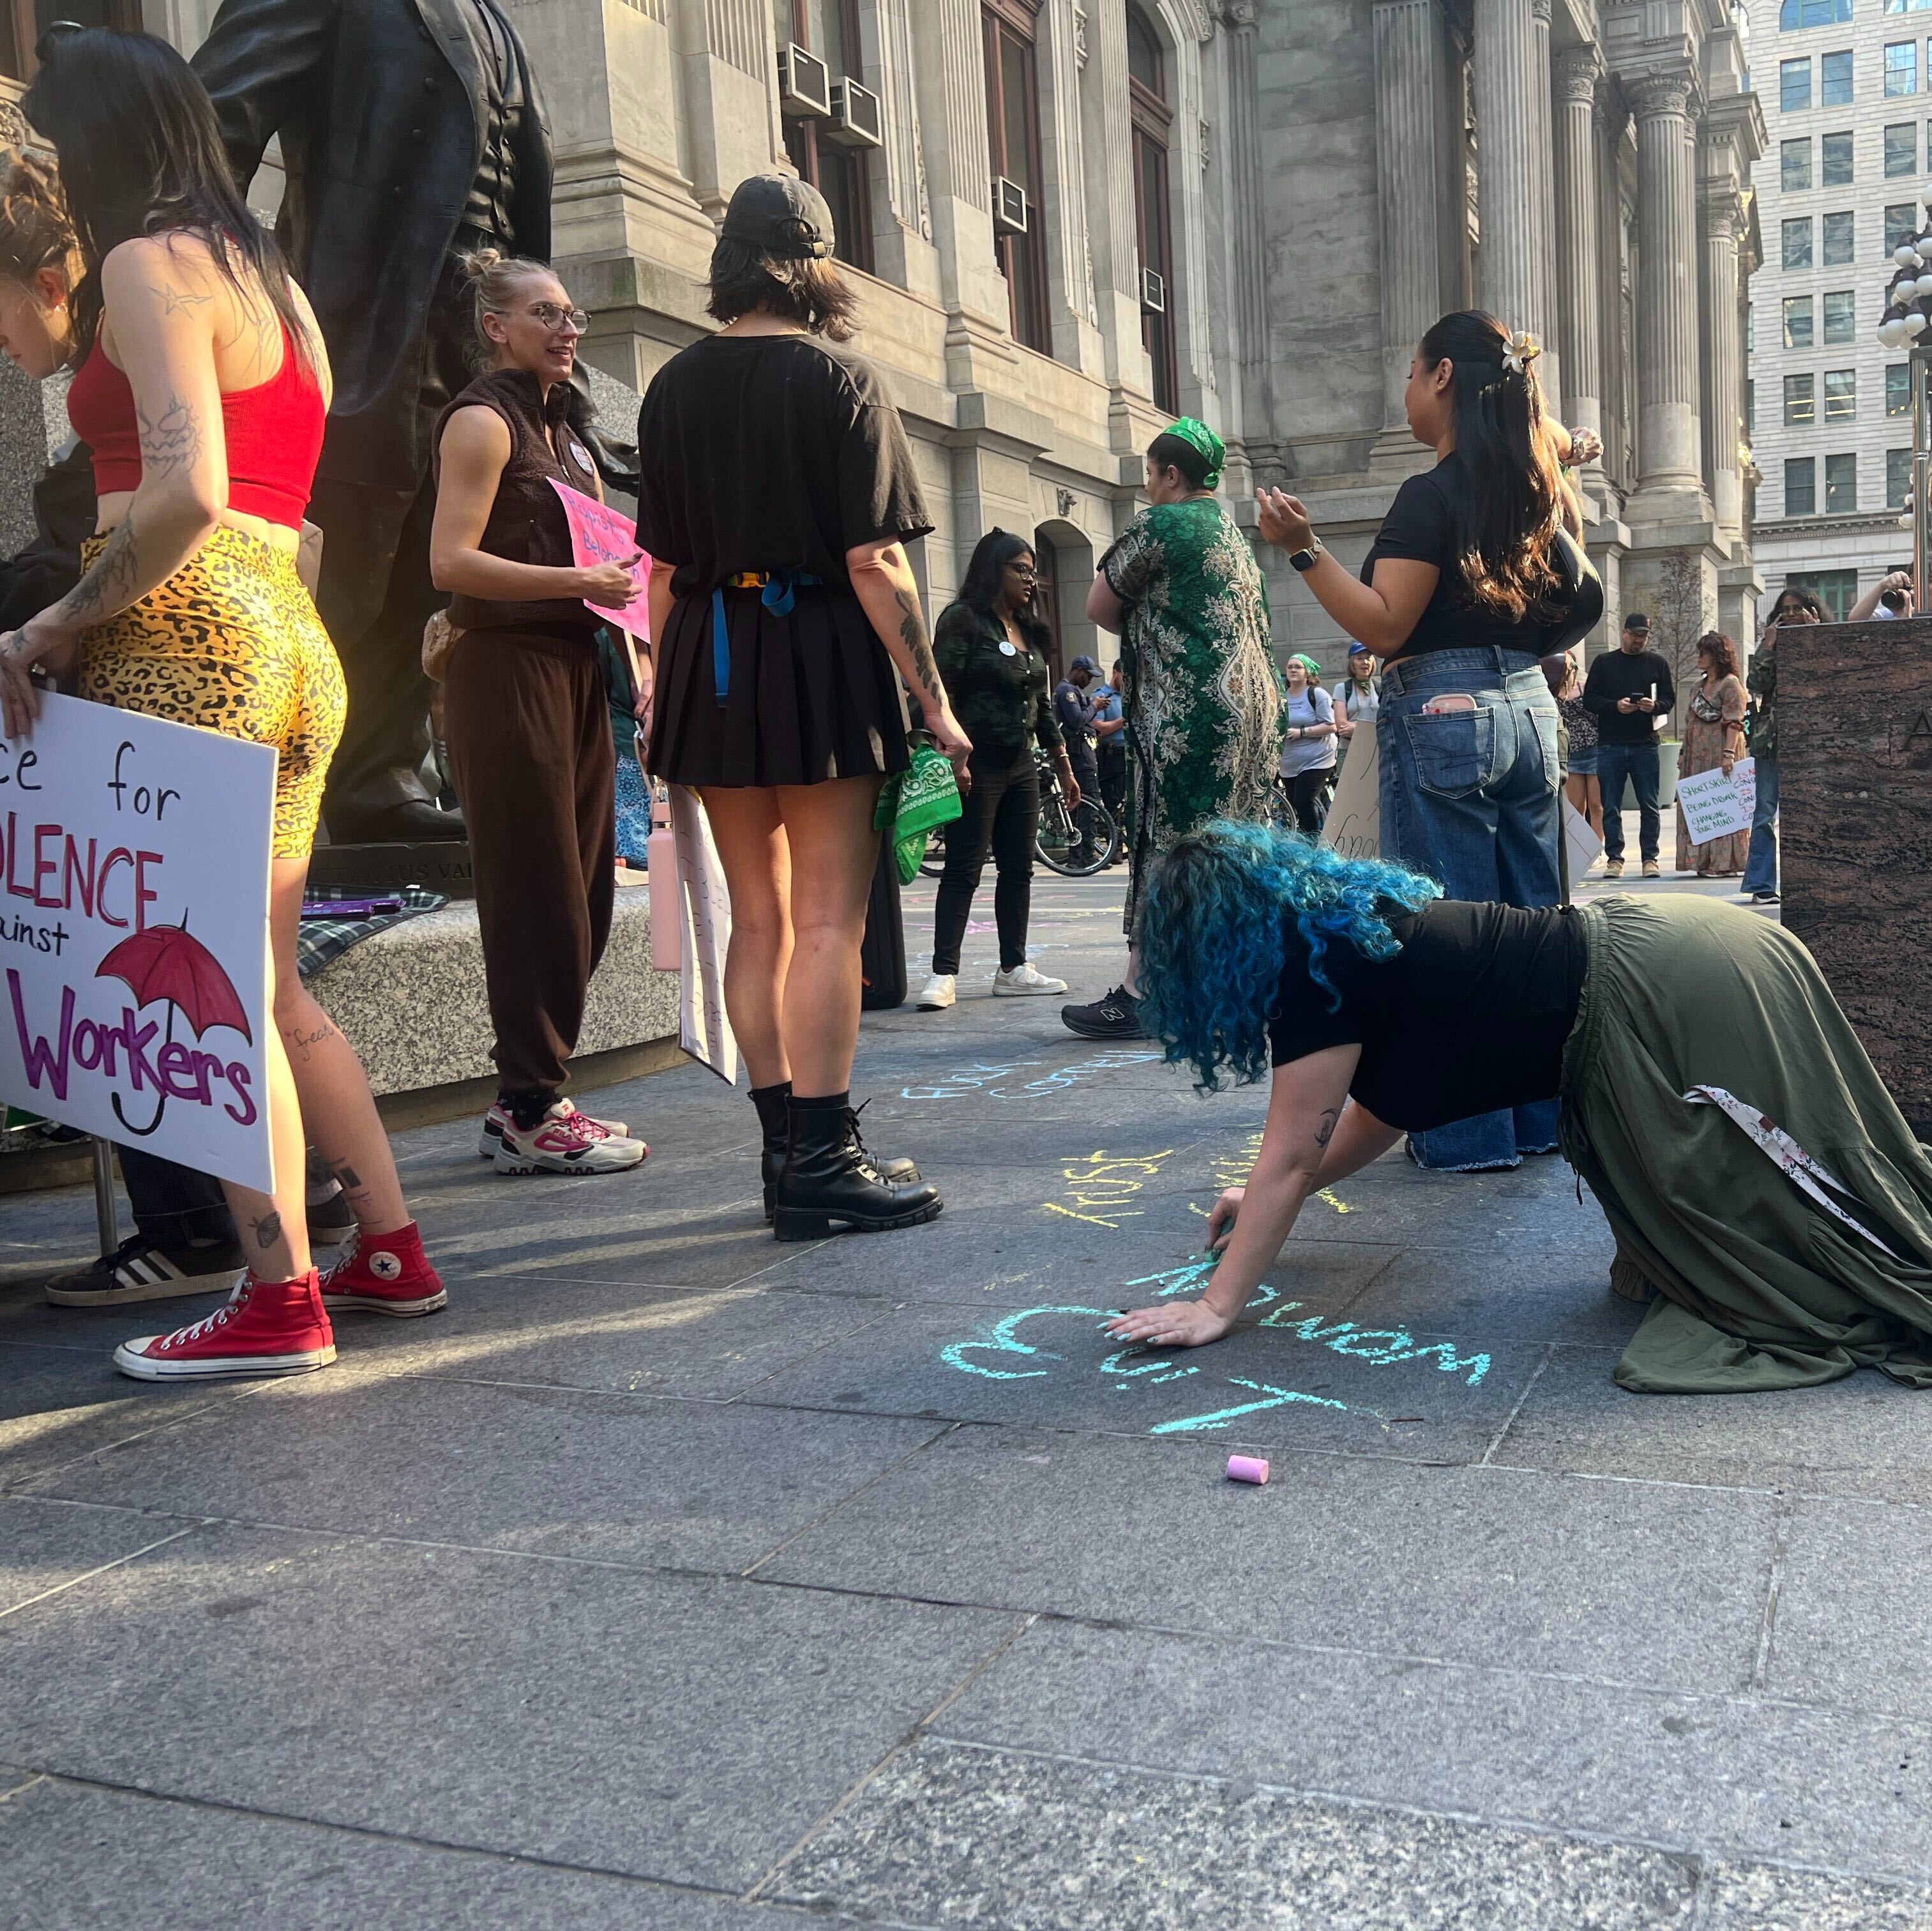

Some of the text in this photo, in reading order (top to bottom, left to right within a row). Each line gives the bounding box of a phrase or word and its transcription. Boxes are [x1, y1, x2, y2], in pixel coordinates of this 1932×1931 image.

[107, 741, 181, 821] for
[1681, 782, 1709, 799] SHORT
[1686, 799, 1711, 813] BEING
[1712, 792, 1738, 805] DRUNK
[1739, 794, 1755, 806] CON
[1694, 816, 1735, 834] YOUR MIND
[6, 967, 257, 1126] Workers
[553, 1128, 572, 1140] FILA
